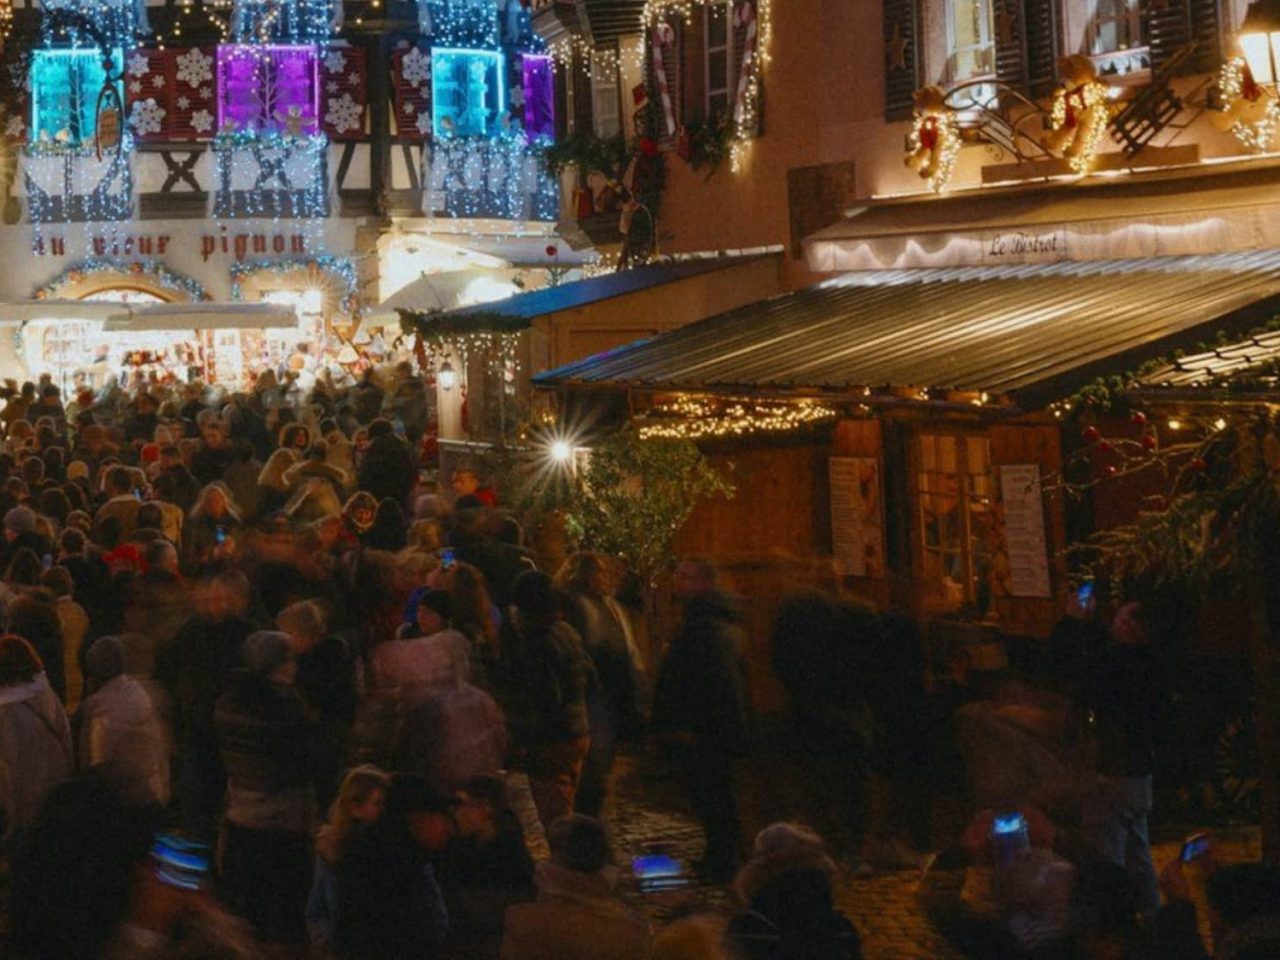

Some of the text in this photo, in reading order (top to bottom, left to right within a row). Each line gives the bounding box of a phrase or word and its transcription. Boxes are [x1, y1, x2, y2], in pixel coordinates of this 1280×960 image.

[200, 226, 305, 262] pignon
[988, 231, 1057, 255] Le Bistrot
